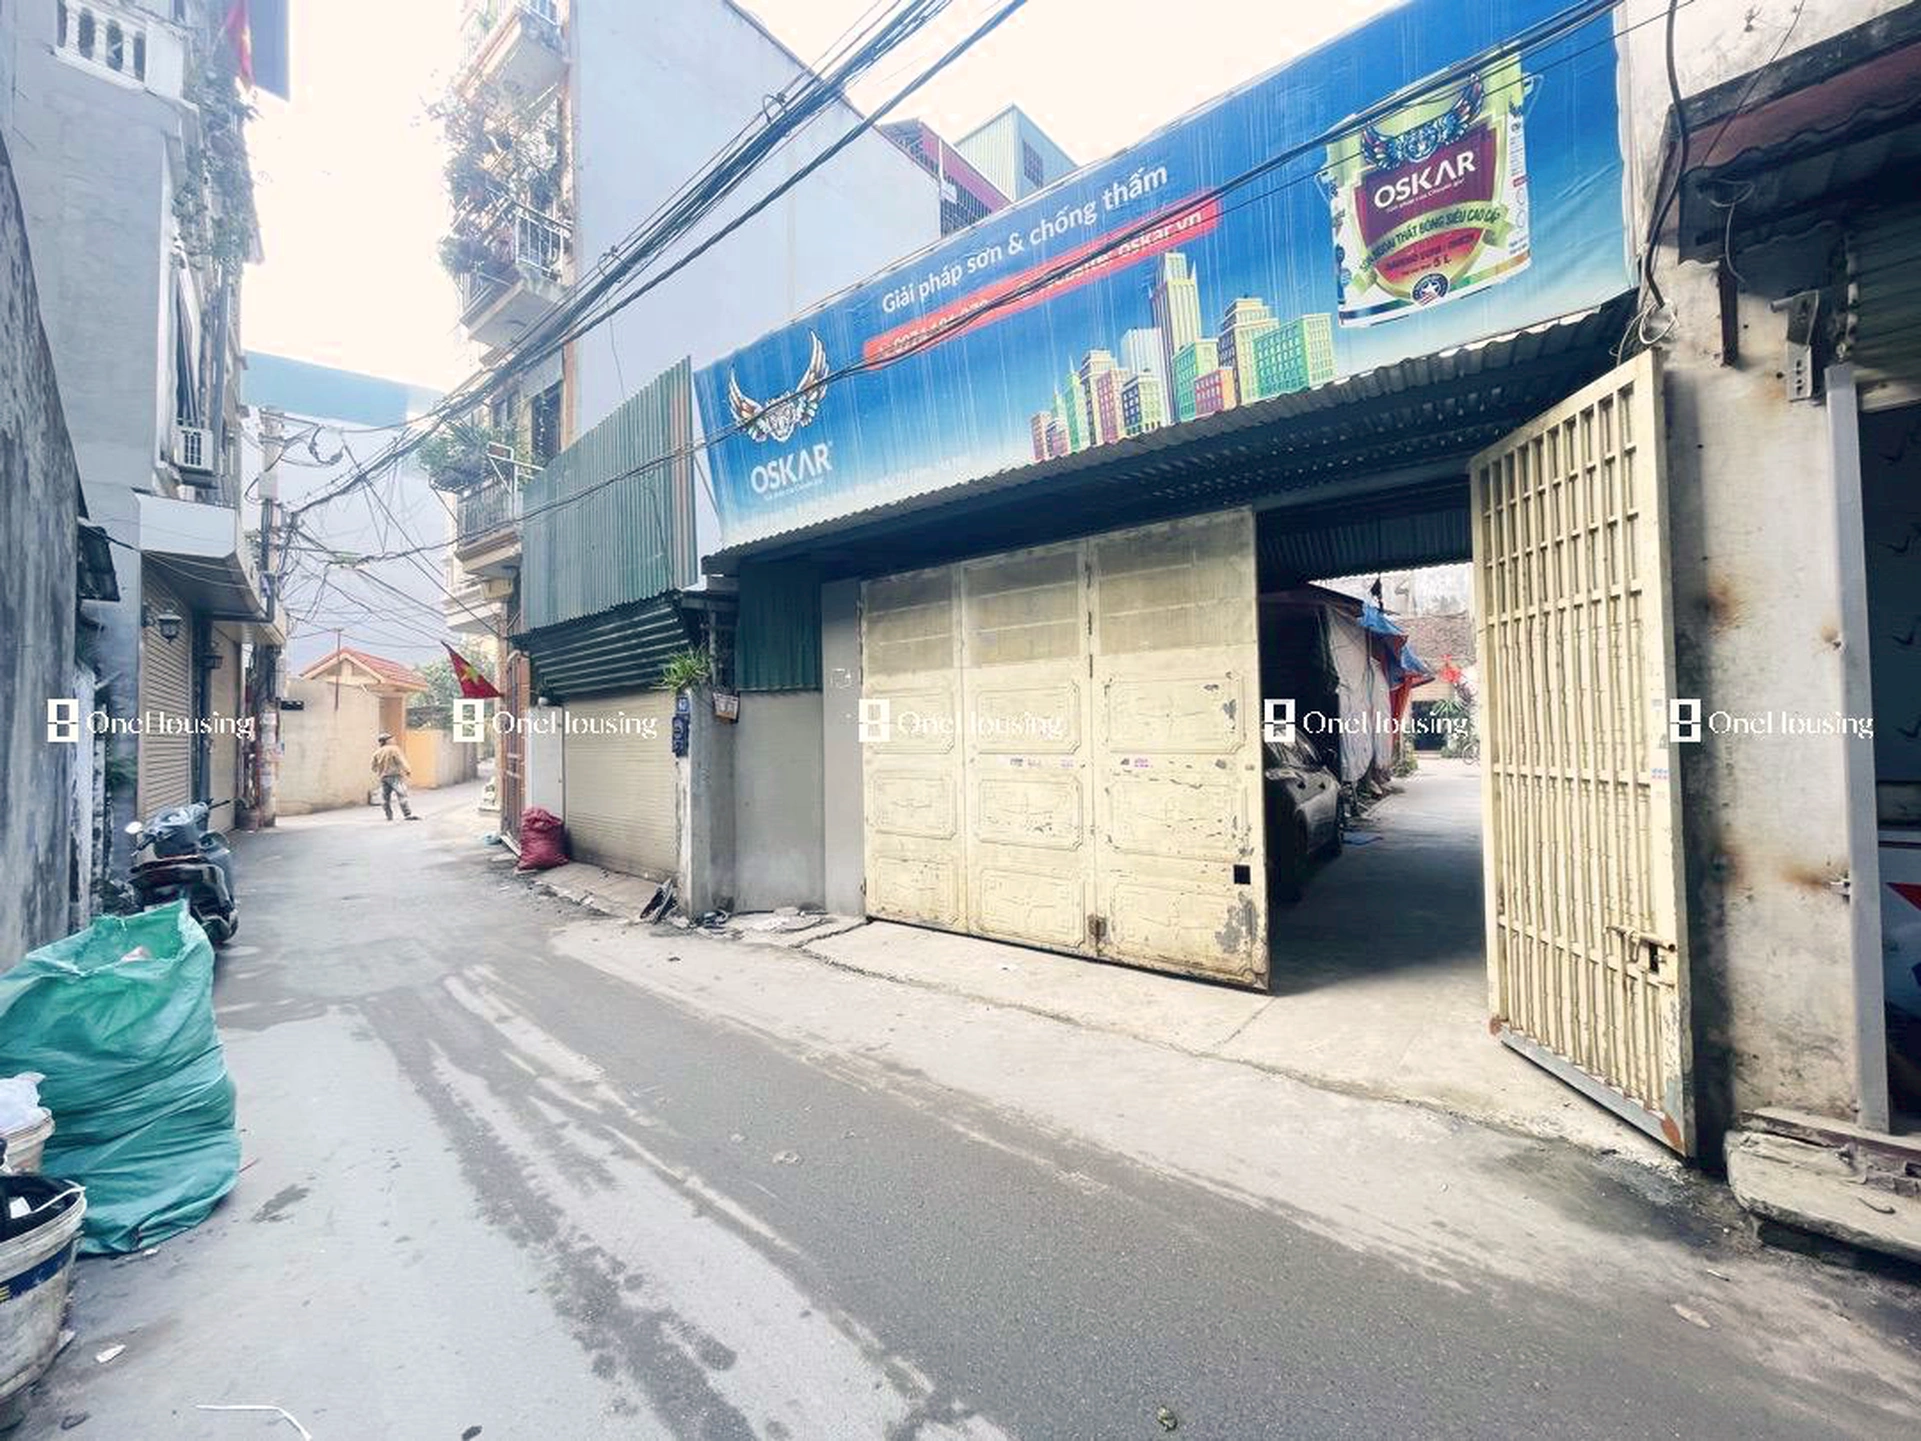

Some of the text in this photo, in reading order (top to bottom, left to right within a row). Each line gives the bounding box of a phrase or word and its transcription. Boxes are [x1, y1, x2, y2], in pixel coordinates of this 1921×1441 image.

[1374, 151, 1476, 208] OSKAR
[882, 283, 914, 313] Giải
[919, 263, 963, 303] pháp
[967, 246, 1002, 271] sơn
[1008, 232, 1024, 255] &
[1029, 201, 1098, 246] chống
[1102, 166, 1168, 211] thấm
[751, 443, 832, 494] OSKAR
